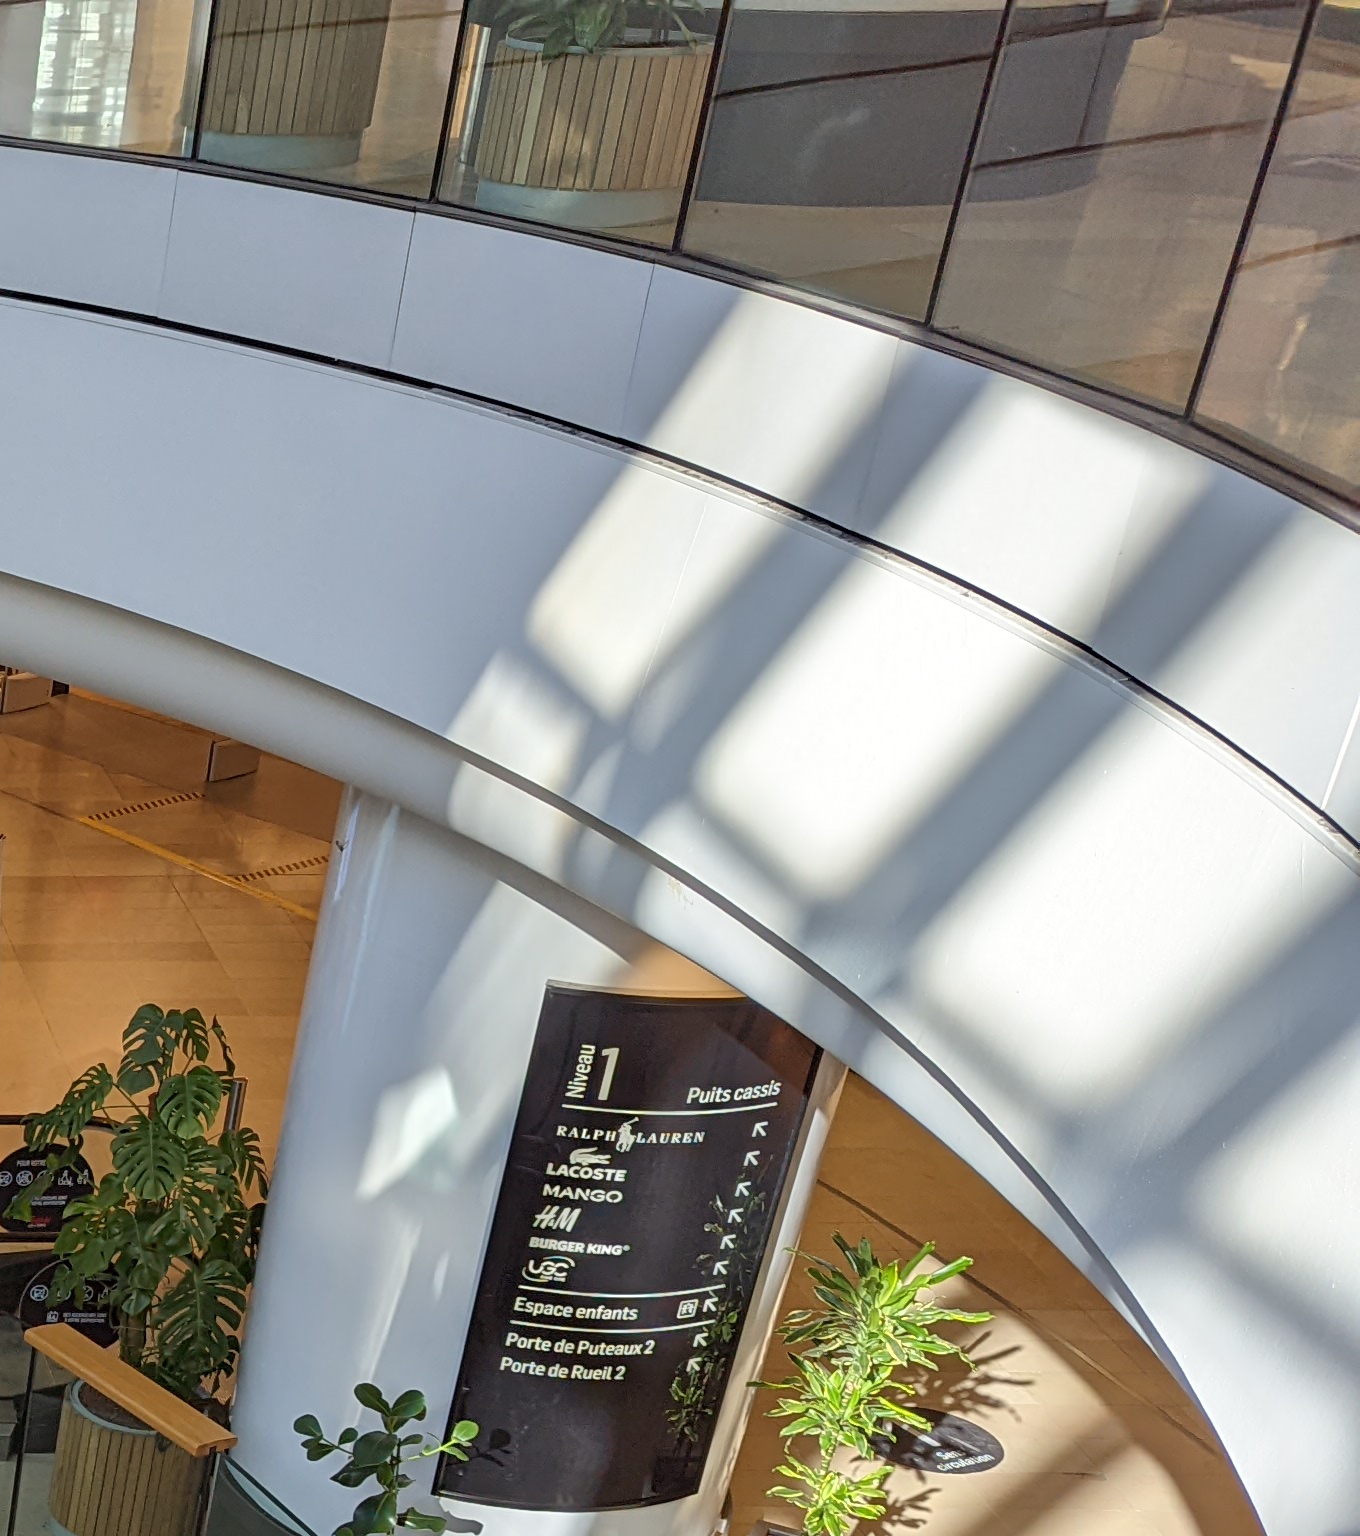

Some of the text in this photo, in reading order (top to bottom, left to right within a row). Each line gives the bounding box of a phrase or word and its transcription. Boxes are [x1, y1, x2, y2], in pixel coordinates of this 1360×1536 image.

[565, 1044, 620, 1101] Niveau 1
[686, 1079, 782, 1105] Puits cassis
[556, 1125, 706, 1144] RALPH LAUREN
[545, 1162, 628, 1182] LACOSTE
[542, 1184, 623, 1203] MANGO
[532, 1204, 582, 1233] H&M
[529, 1236, 586, 1254] BURGER
[528, 1259, 570, 1277] UGC
[513, 1296, 639, 1321] Espace enfants
[505, 1332, 655, 1356] Porte de Puteaux 2
[499, 1356, 627, 1381] Porte de Rueil 2
[936, 1453, 996, 1472] circulation
